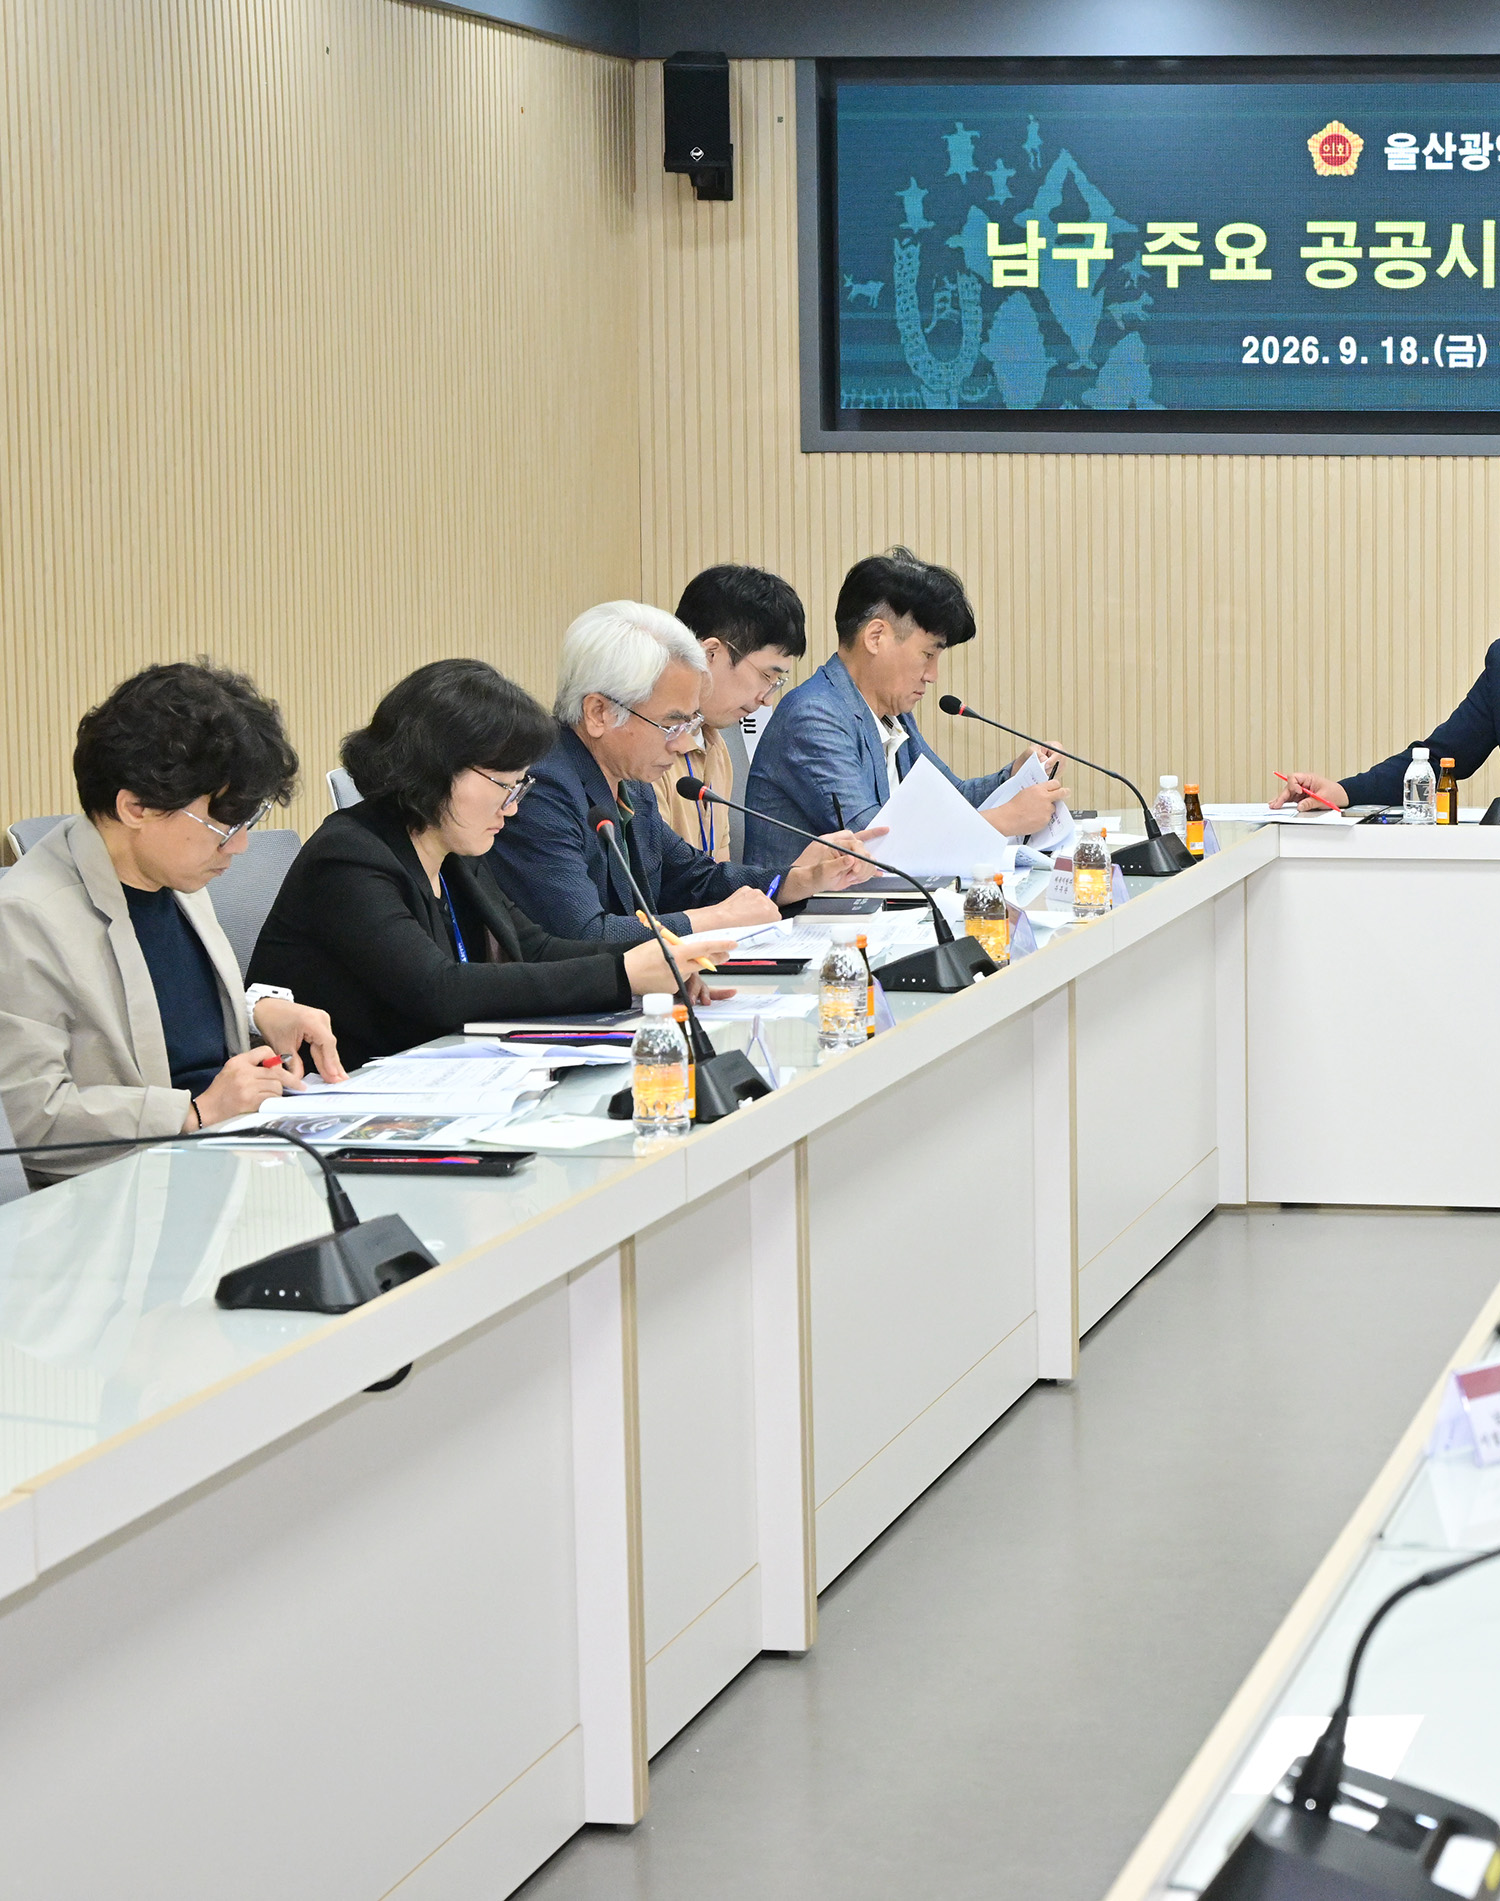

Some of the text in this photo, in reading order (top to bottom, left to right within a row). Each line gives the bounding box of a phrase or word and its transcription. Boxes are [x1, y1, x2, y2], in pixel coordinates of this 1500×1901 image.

[1322, 142, 1350, 157] 의회
[987, 220, 1114, 289] 남구
[1141, 221, 1272, 288] 주요
[1241, 335, 1330, 365] 2026.
